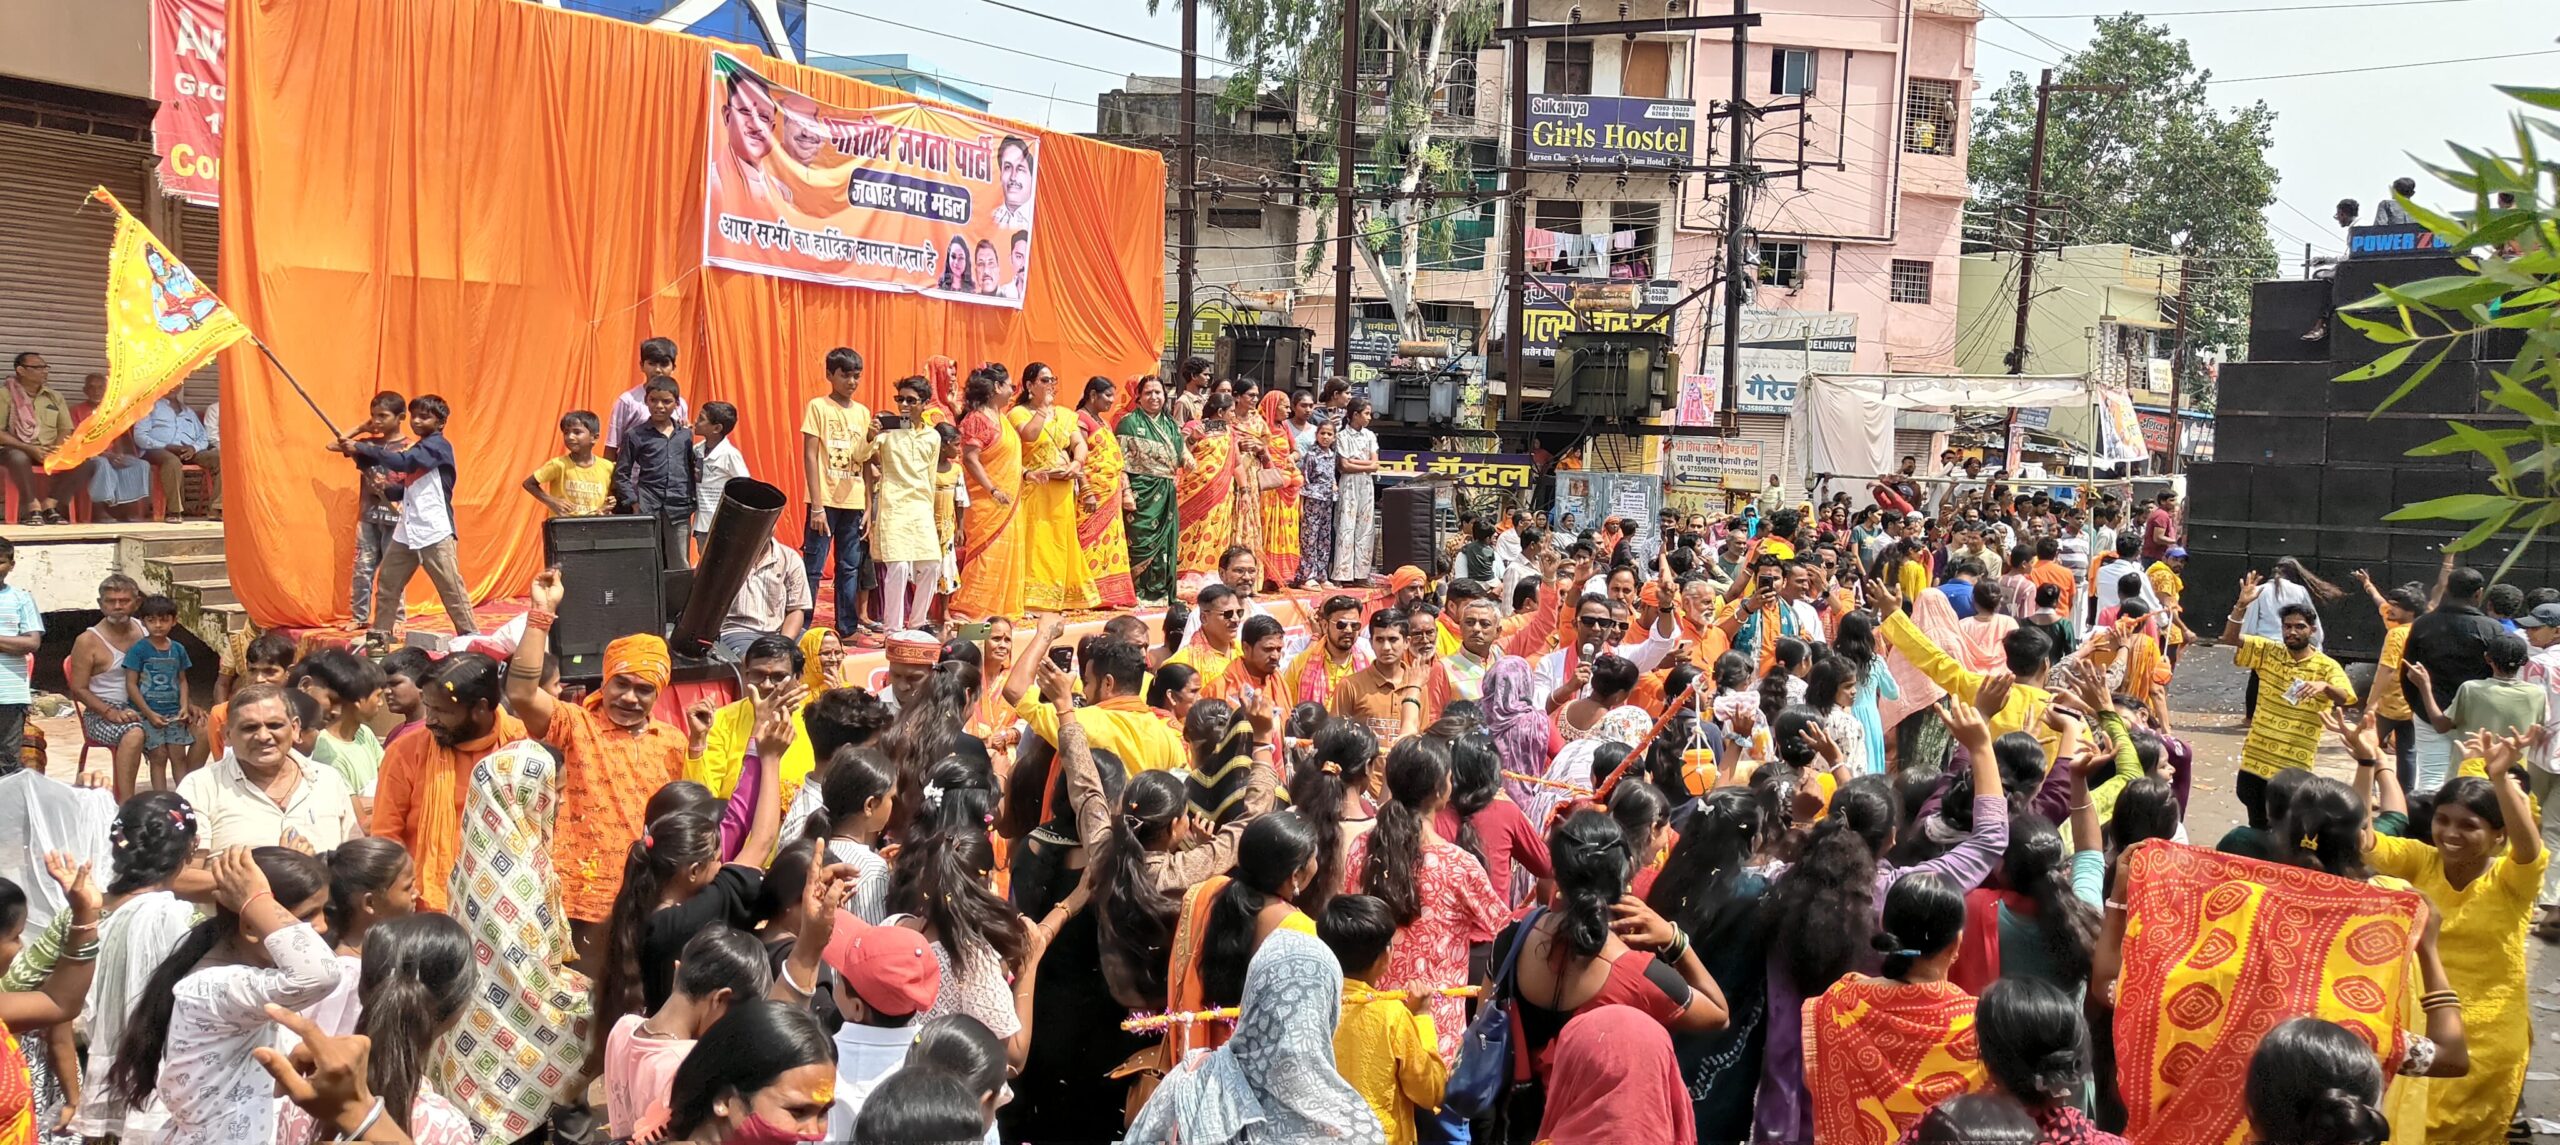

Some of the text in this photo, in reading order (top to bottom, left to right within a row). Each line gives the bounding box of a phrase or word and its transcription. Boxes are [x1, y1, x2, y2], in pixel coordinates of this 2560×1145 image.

[1532, 97, 1588, 117] Sukanya
[823, 114, 992, 182] भारतीय जनता पार्टी
[1532, 120, 1687, 152] Girls Hostel
[852, 177, 968, 221] जवाहर नगर मंडल
[721, 216, 751, 243] आप
[756, 219, 789, 246] सभी
[794, 230, 810, 254] का
[814, 228, 854, 261] हार्दिक
[926, 240, 937, 273] है
[2352, 233, 2416, 252] POWER
[1740, 316, 1856, 342] COURIER
